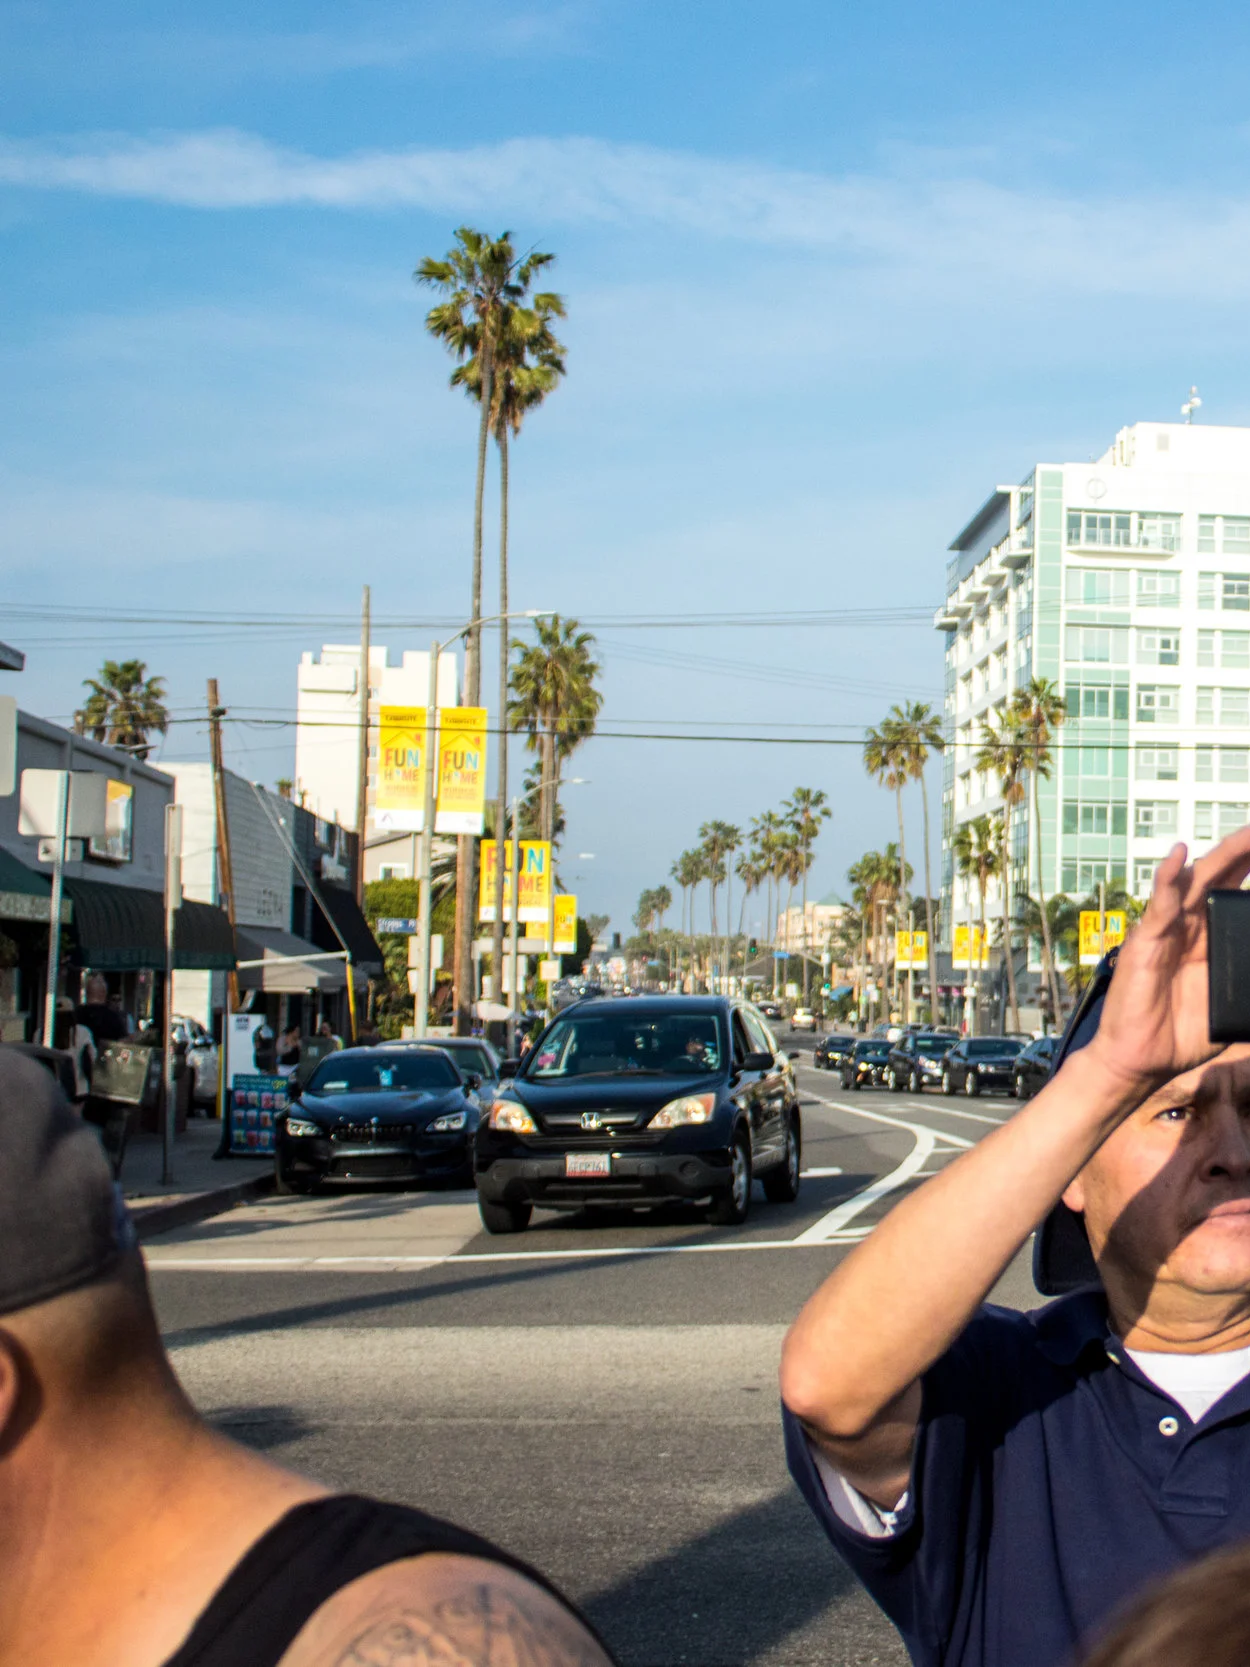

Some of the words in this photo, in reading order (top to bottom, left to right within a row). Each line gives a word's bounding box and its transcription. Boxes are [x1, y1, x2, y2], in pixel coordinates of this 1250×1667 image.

[384, 748, 419, 767] FUN
[443, 751, 478, 769] FUN
[1083, 916, 1121, 933] FUN
